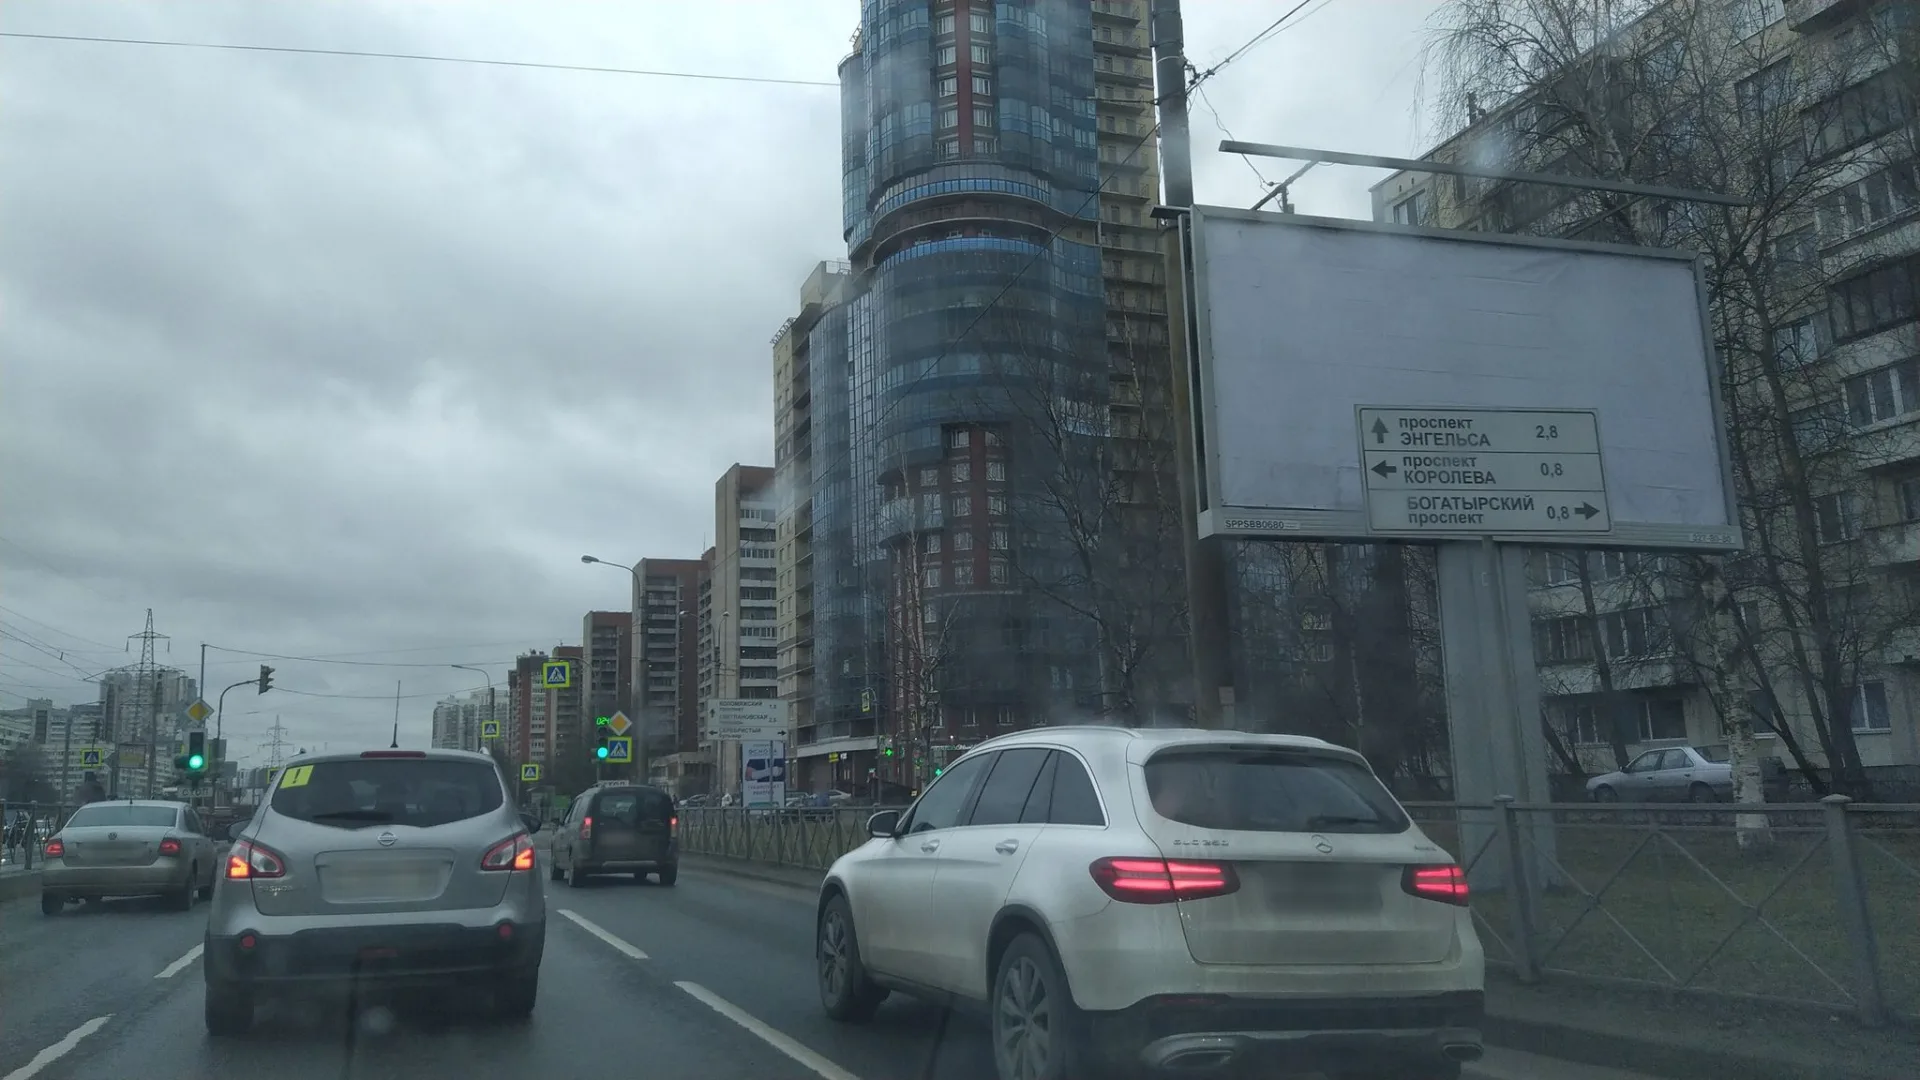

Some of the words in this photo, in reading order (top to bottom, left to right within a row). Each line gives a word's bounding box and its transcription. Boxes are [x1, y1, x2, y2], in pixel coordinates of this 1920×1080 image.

[1399, 417, 1473, 431] проспект
[1401, 432, 1491, 447] ЭНГЕЛЬСА
[1535, 425, 1559, 441] 2,8
[1403, 455, 1477, 469] проспект
[1404, 470, 1496, 485] КОРОЛЕВА
[1540, 463, 1564, 478] 0,8
[1408, 495, 1535, 511] БОГАТЫРСКИЙ
[1546, 506, 1570, 522] 0,8
[1408, 513, 1484, 527] проспект
